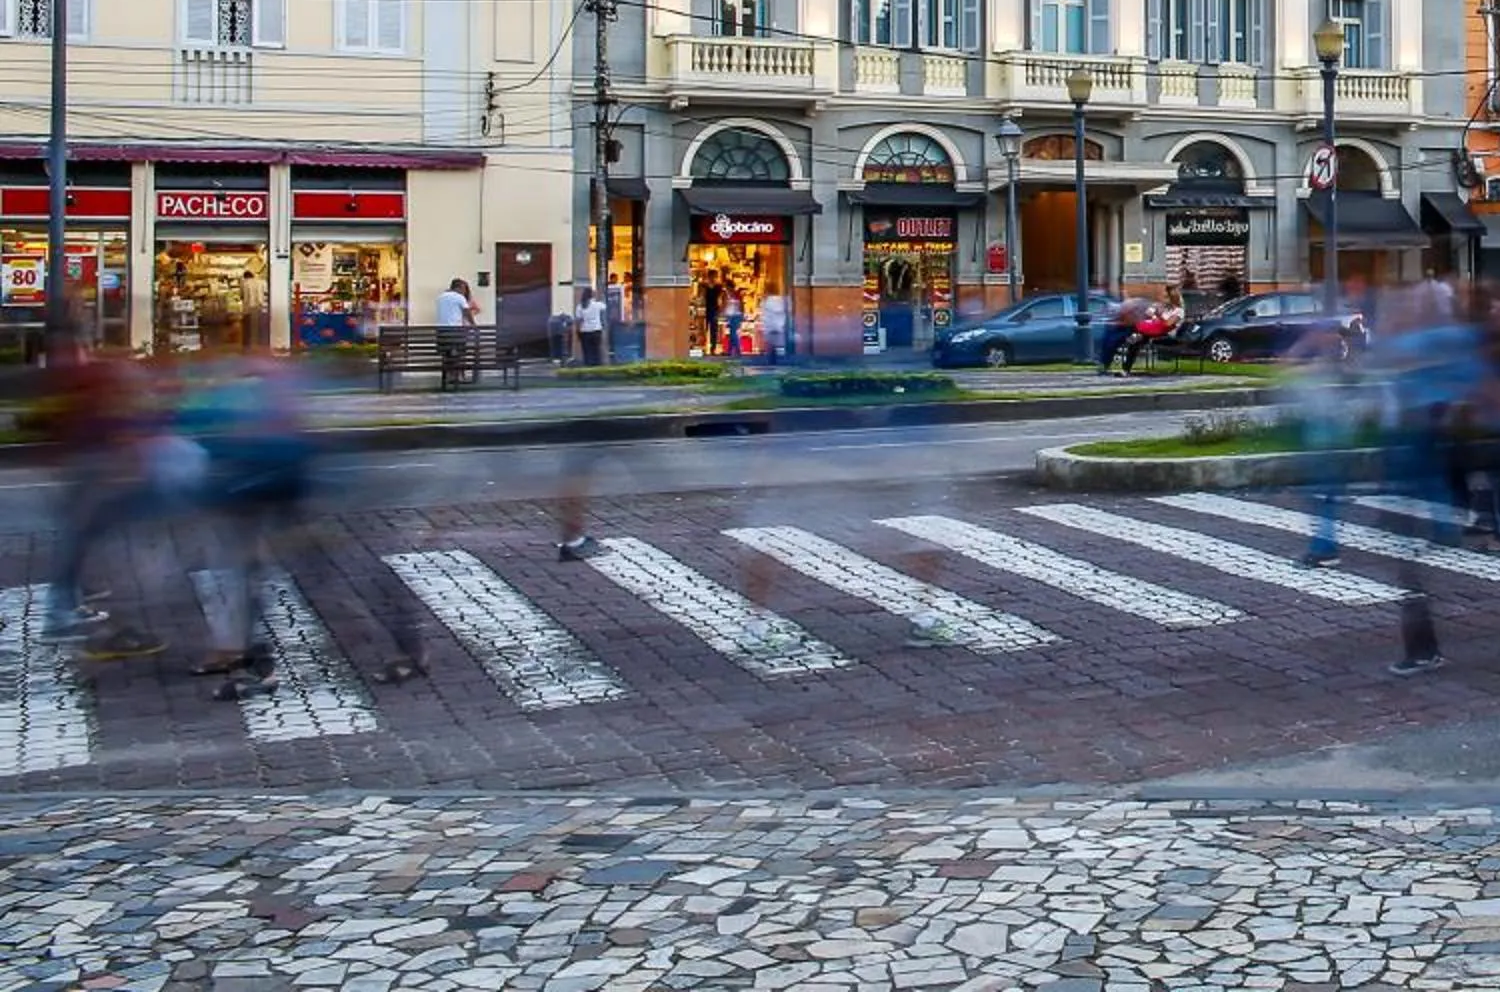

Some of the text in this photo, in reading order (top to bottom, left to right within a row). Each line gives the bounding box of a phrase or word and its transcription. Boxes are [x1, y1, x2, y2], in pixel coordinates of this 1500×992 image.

[161, 196, 263, 215] PACHECO
[896, 217, 953, 237] OUTLET
[11, 269, 37, 286] 80
